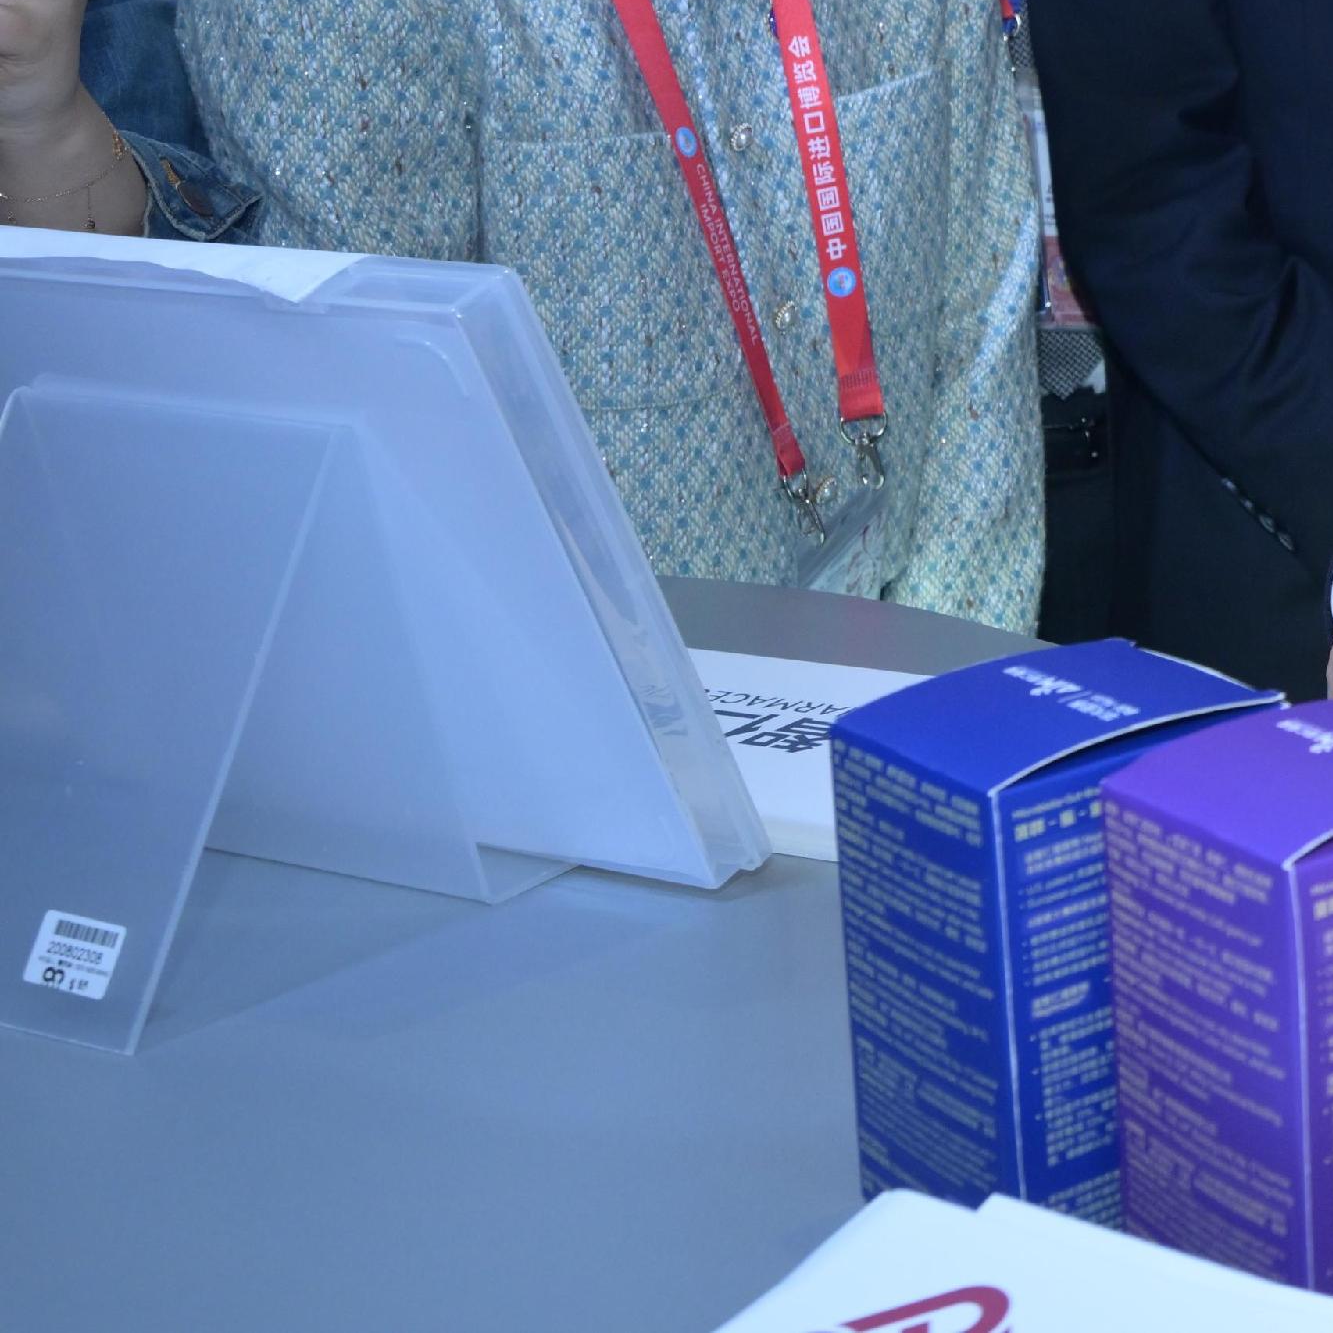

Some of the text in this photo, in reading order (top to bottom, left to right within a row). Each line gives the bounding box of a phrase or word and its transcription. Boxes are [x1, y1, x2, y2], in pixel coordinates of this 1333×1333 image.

[789, 35, 846, 261] 中国国际进口博览会
[693, 161, 762, 347] CHINA INTERNATIONAL
[698, 202, 743, 314] IMPORT EXPO
